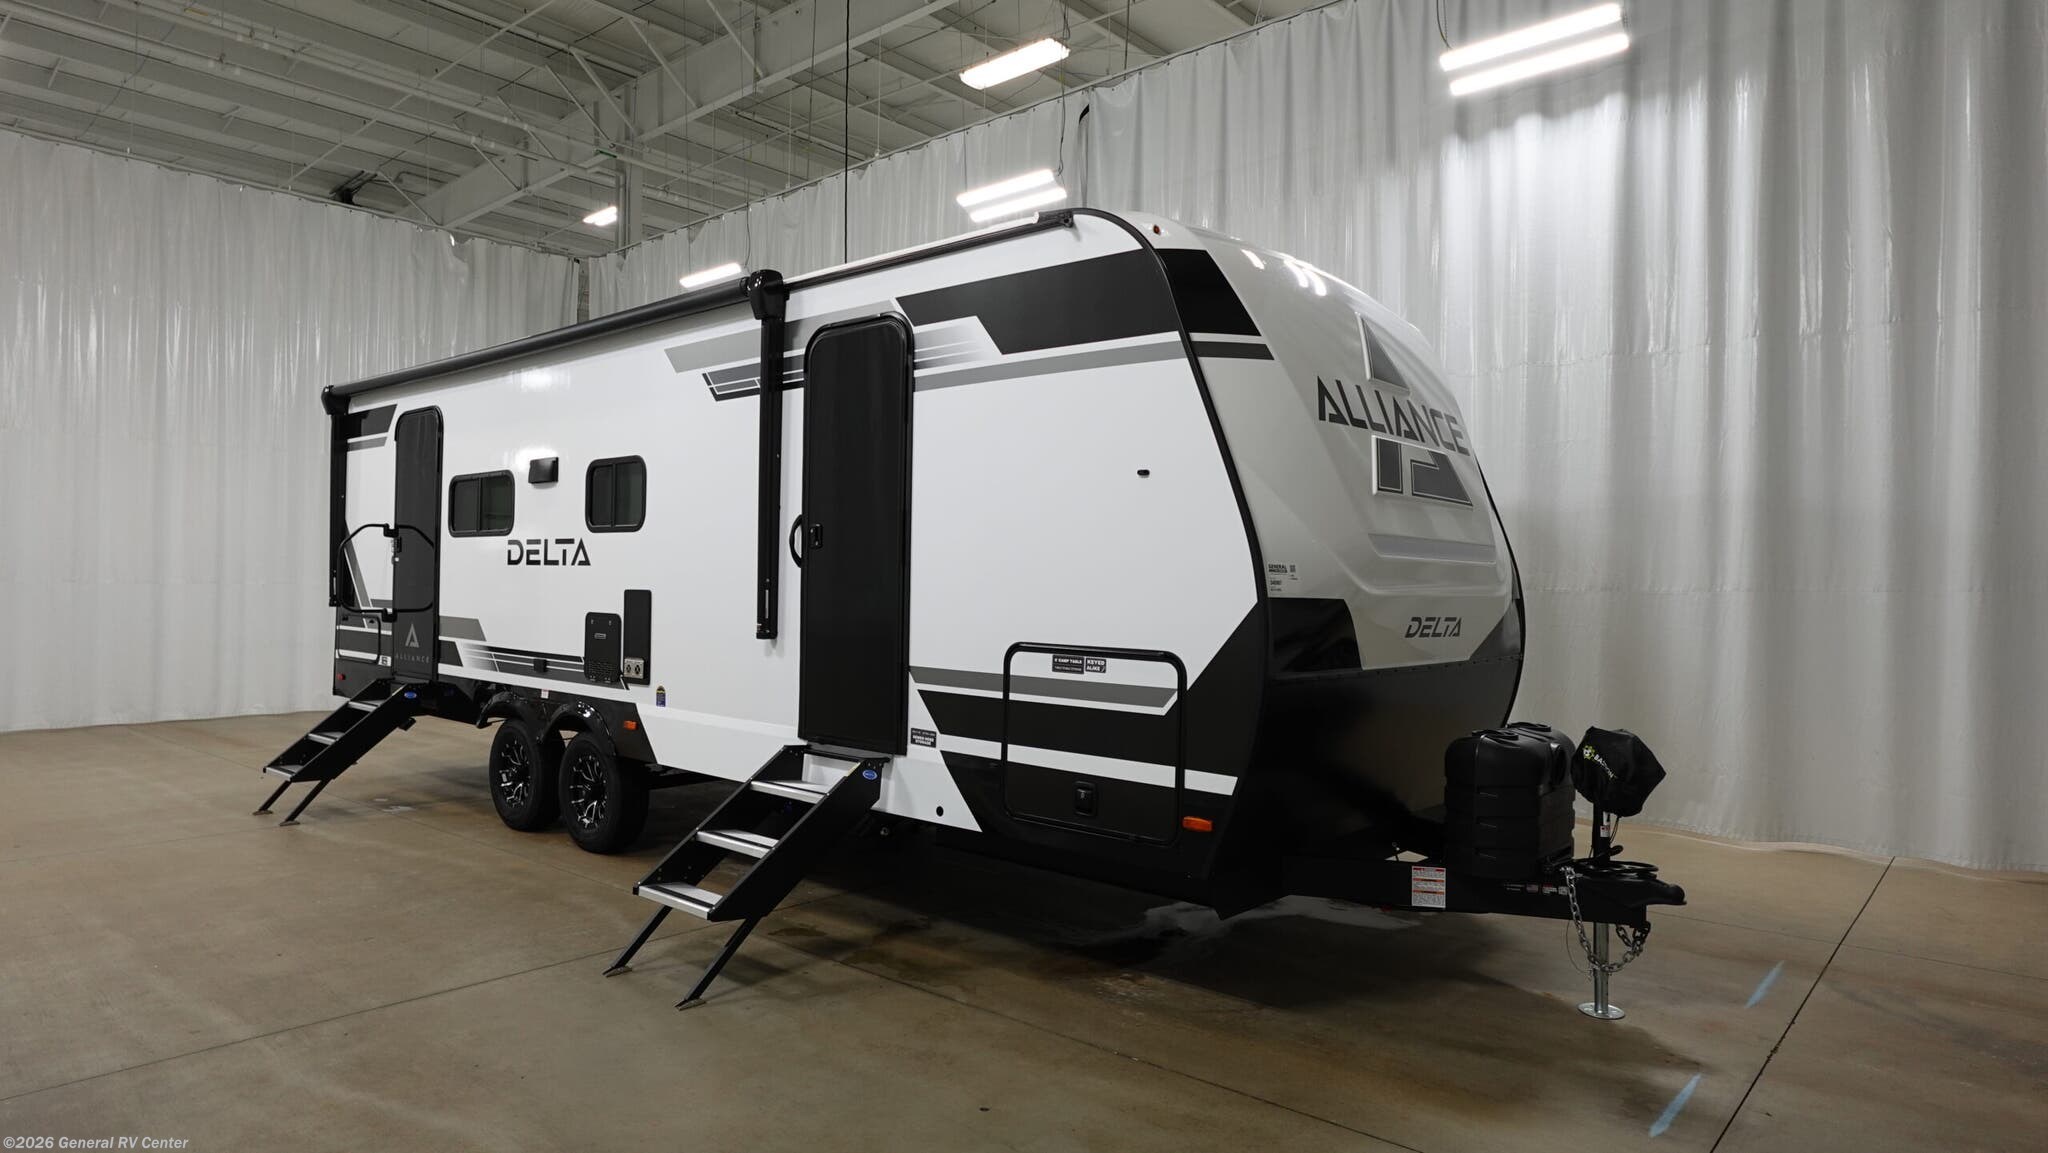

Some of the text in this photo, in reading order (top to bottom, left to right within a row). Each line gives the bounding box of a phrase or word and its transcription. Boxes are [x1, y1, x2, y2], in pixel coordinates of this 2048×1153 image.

[1317, 375, 1471, 457] ALLIANCE
[507, 537, 591, 566] DELTA
[1405, 616, 1462, 638] DELTA
[395, 653, 430, 663] ALLIANCE
